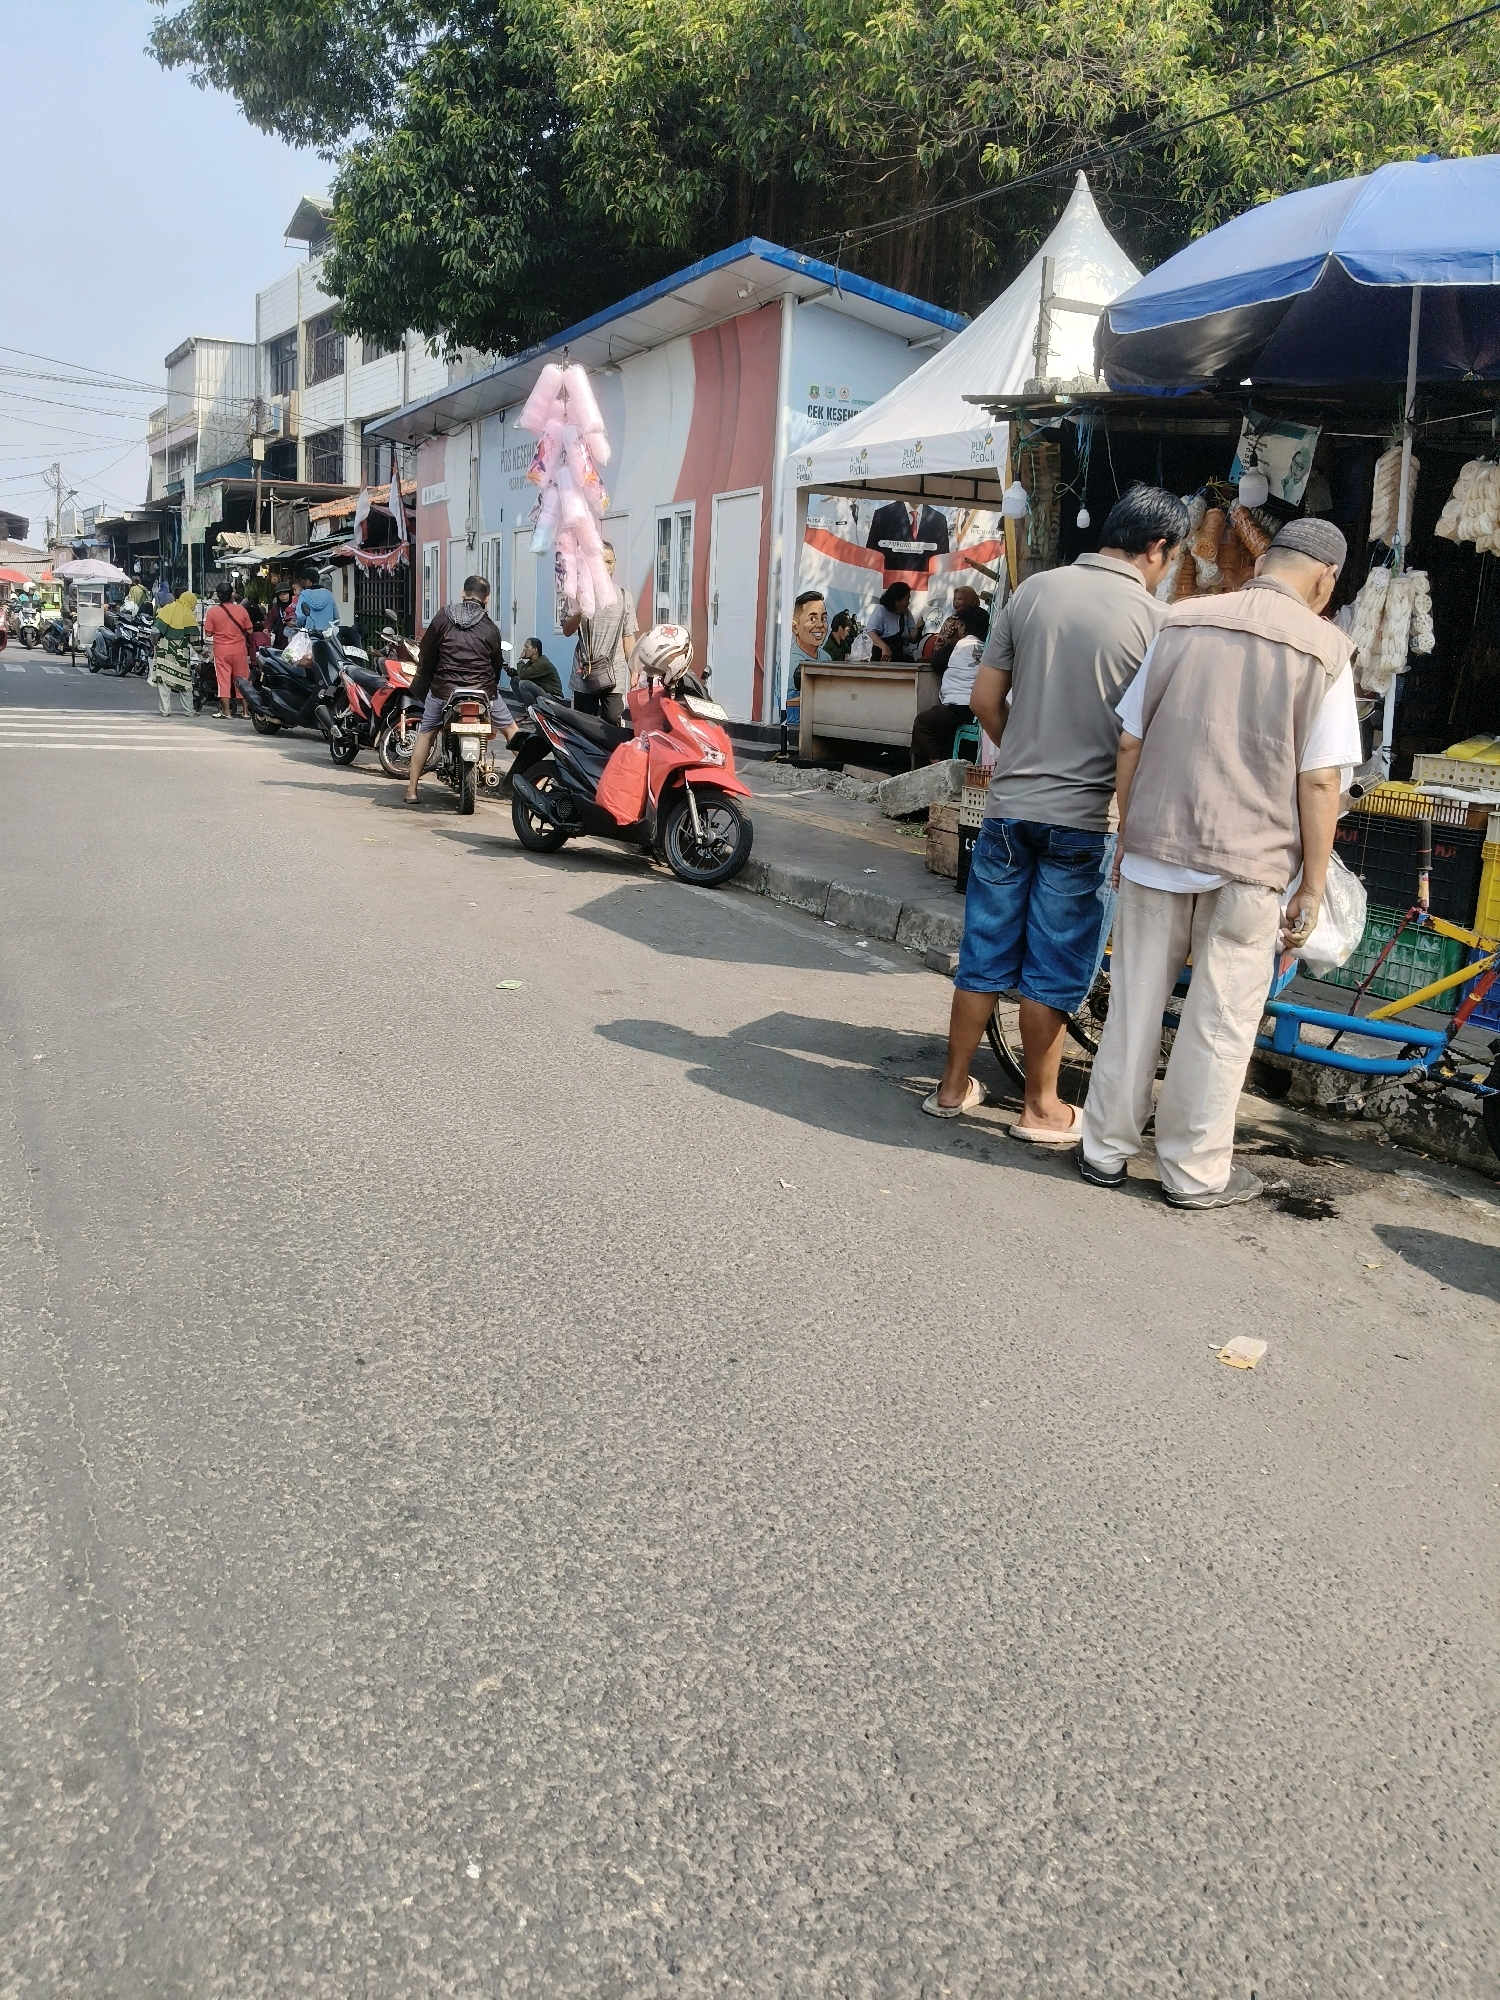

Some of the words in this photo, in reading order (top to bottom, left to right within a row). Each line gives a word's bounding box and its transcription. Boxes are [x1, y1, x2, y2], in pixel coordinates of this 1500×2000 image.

[807, 404, 824, 420] CEK
[826, 406, 862, 422] KESEH
[971, 441, 984, 451] PLN
[903, 448, 915, 458] PLN
[970, 449, 995, 463] Peduli
[500, 448, 512, 474] POS
[850, 456, 861, 465] PLN
[901, 456, 924, 470] Peduli
[849, 463, 869, 476] Peduli
